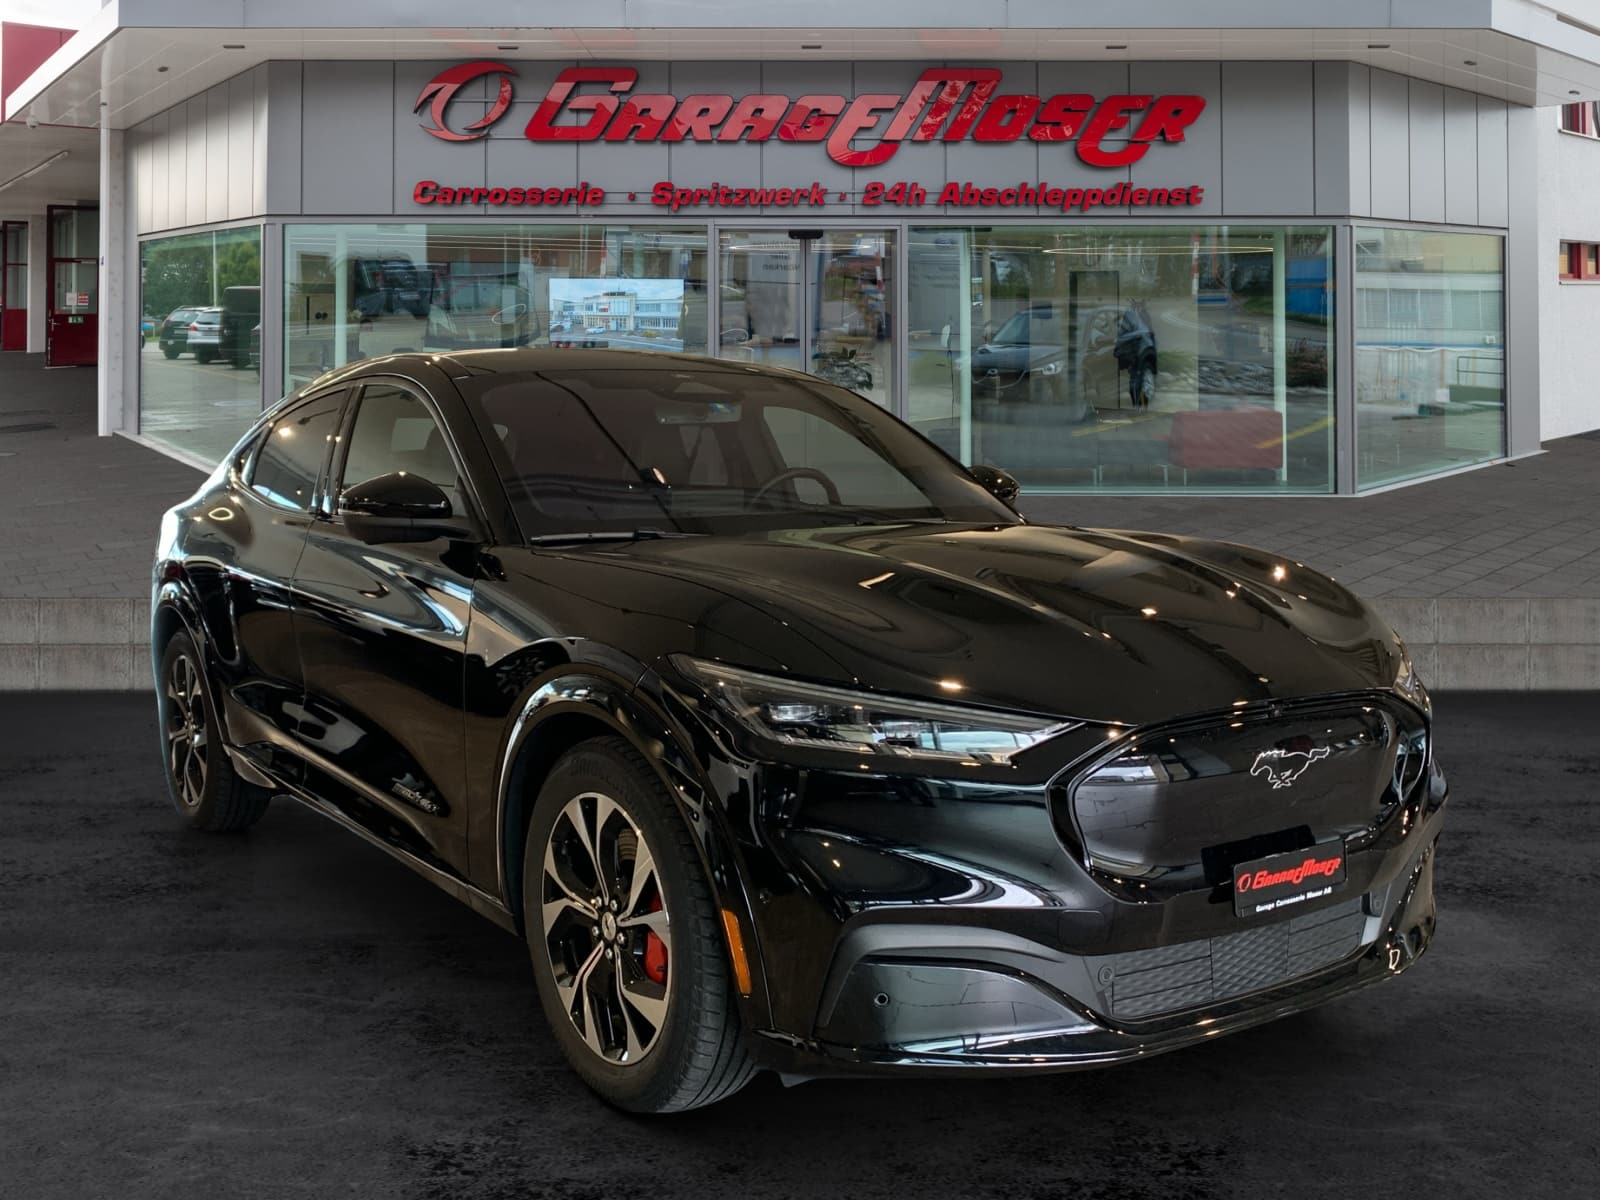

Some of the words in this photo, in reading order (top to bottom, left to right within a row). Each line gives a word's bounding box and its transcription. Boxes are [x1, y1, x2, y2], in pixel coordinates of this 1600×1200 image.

[413, 181, 605, 206] Carrosserie
[651, 181, 827, 211] Spritzwerk
[862, 182, 927, 206] 24h
[937, 182, 1204, 211] Abschleppdienst
